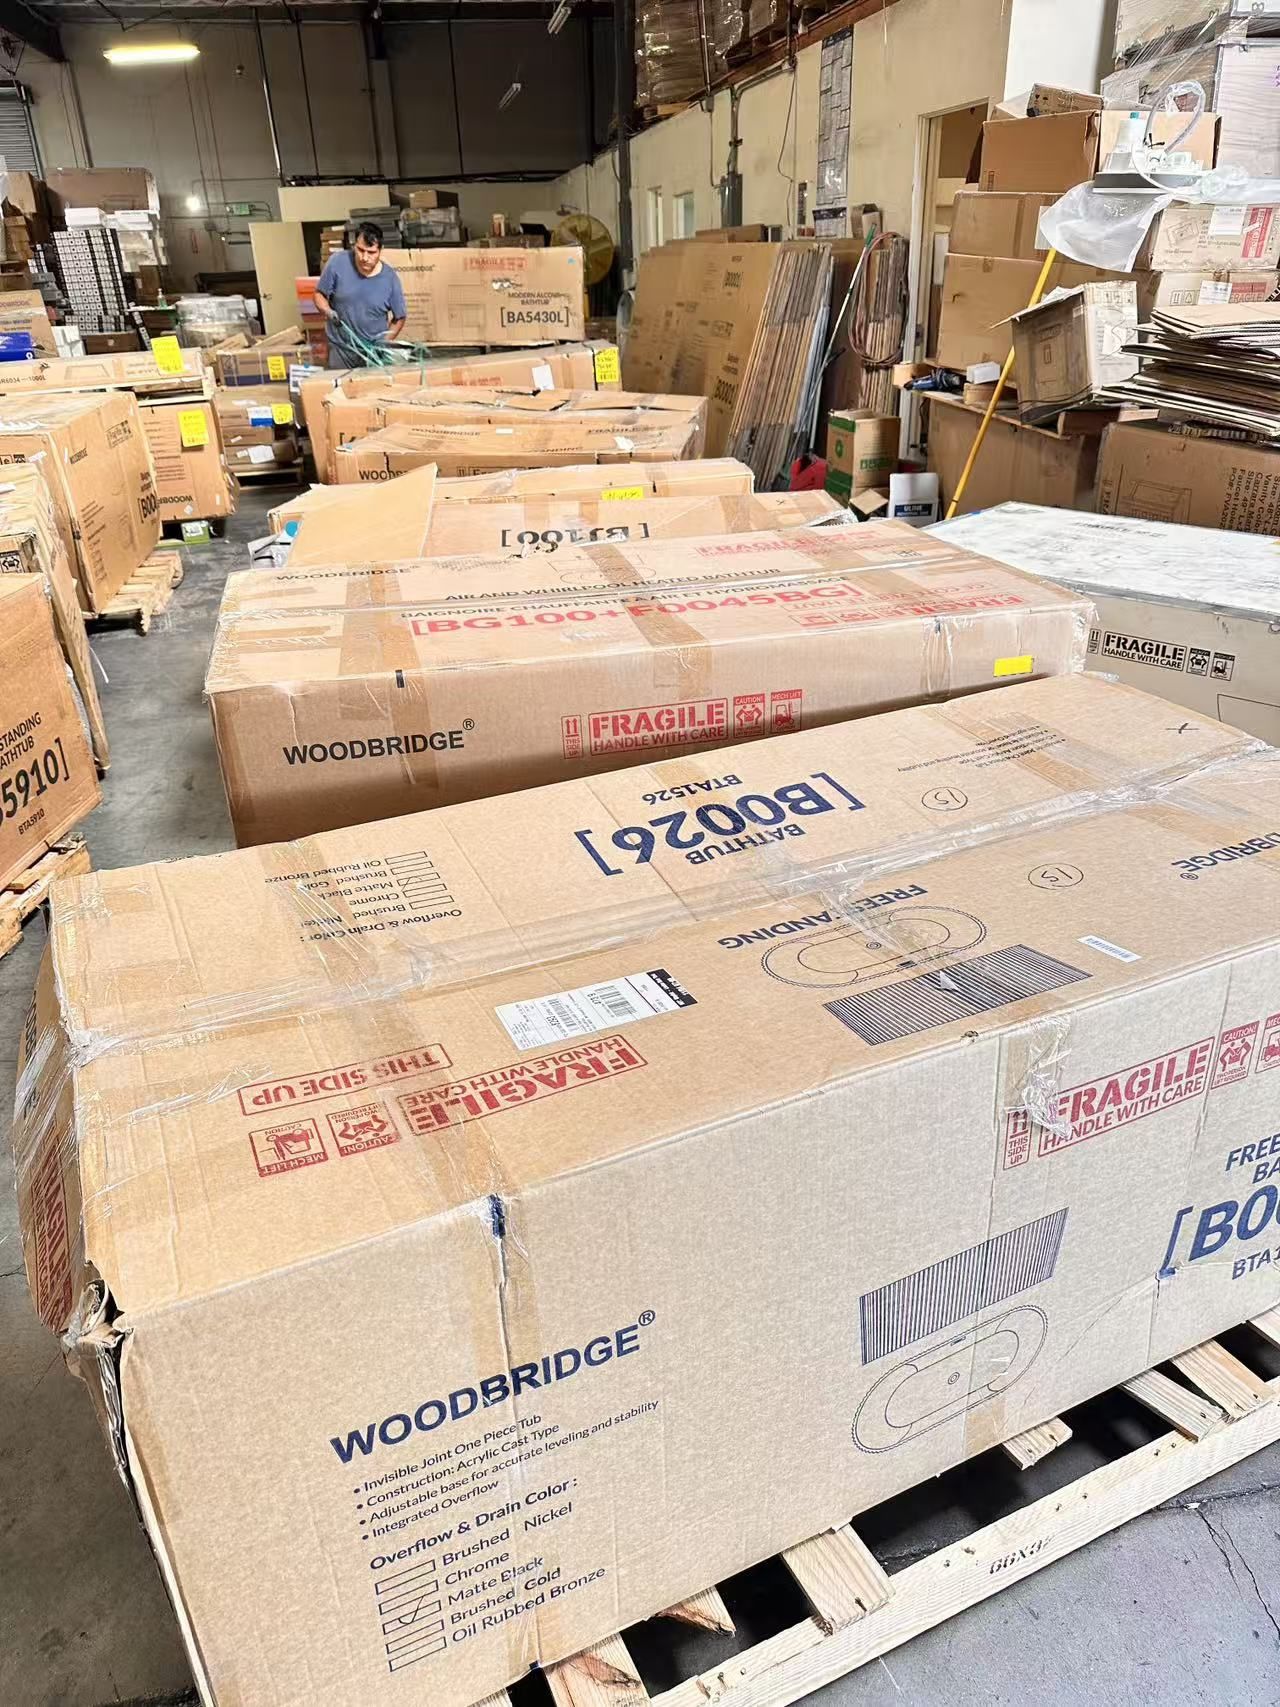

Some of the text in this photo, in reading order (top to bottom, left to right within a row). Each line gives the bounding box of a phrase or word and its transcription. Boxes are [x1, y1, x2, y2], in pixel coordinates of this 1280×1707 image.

[501, 306, 569, 327] [BA5430L]
[478, 590, 519, 599] AND
[523, 580, 628, 597] WHIRLPOOL
[1104, 647, 1182, 669] HANDLE WITH CARE
[1105, 634, 1185, 661] FRAGILE
[592, 703, 725, 739] FRAGILE
[565, 737, 580, 746] THIS
[593, 734, 649, 752] HANDLE
[651, 730, 688, 745] WITH
[690, 726, 725, 741] CARE
[642, 774, 743, 805] BTA1526
[18, 808, 45, 835] BTA5910
[685, 824, 807, 865] BATHTUB
[313, 862, 361, 877] Rubbed
[336, 870, 387, 885] Brushed
[364, 860, 381, 870] Oil
[349, 892, 399, 906] Chrome
[354, 881, 393, 893] Matte
[352, 904, 406, 920] Brushed
[402, 909, 462, 925] Overflow
[348, 922, 387, 935] Drain
[1224, 1024, 1257, 1042] CAUTION!
[252, 1049, 439, 1107] THIS SIDE UP
[405, 1037, 623, 1107] HANDLE WITH CARE
[411, 1047, 641, 1128] FRAGILE
[1116, 1093, 1159, 1126] WITH
[1162, 1077, 1202, 1103] CARE
[1007, 1144, 1028, 1158] SIDE
[1008, 1134, 1029, 1149] THIS
[262, 1150, 326, 1174] MECH LIFT
[1010, 1154, 1024, 1165] UP
[364, 1413, 542, 1493] Invisible Joint One Piece Tub
[367, 1423, 560, 1507] Construction: Acrylic Cast Type
[369, 1400, 659, 1524] Adjustable base for accurate leveling and stability
[372, 1479, 499, 1539] Integrated Overflow
[371, 1529, 453, 1570] Overflow
[457, 1521, 471, 1534] &
[475, 1500, 521, 1527] Drain
[526, 1480, 571, 1505] Color
[442, 1502, 573, 1566] Brushed Nickel
[445, 1552, 510, 1586] Chrome
[448, 1577, 497, 1606] Matte
[450, 1568, 561, 1625] Brushed Gold
[452, 1567, 606, 1643] Oil Rubbed Bronze
